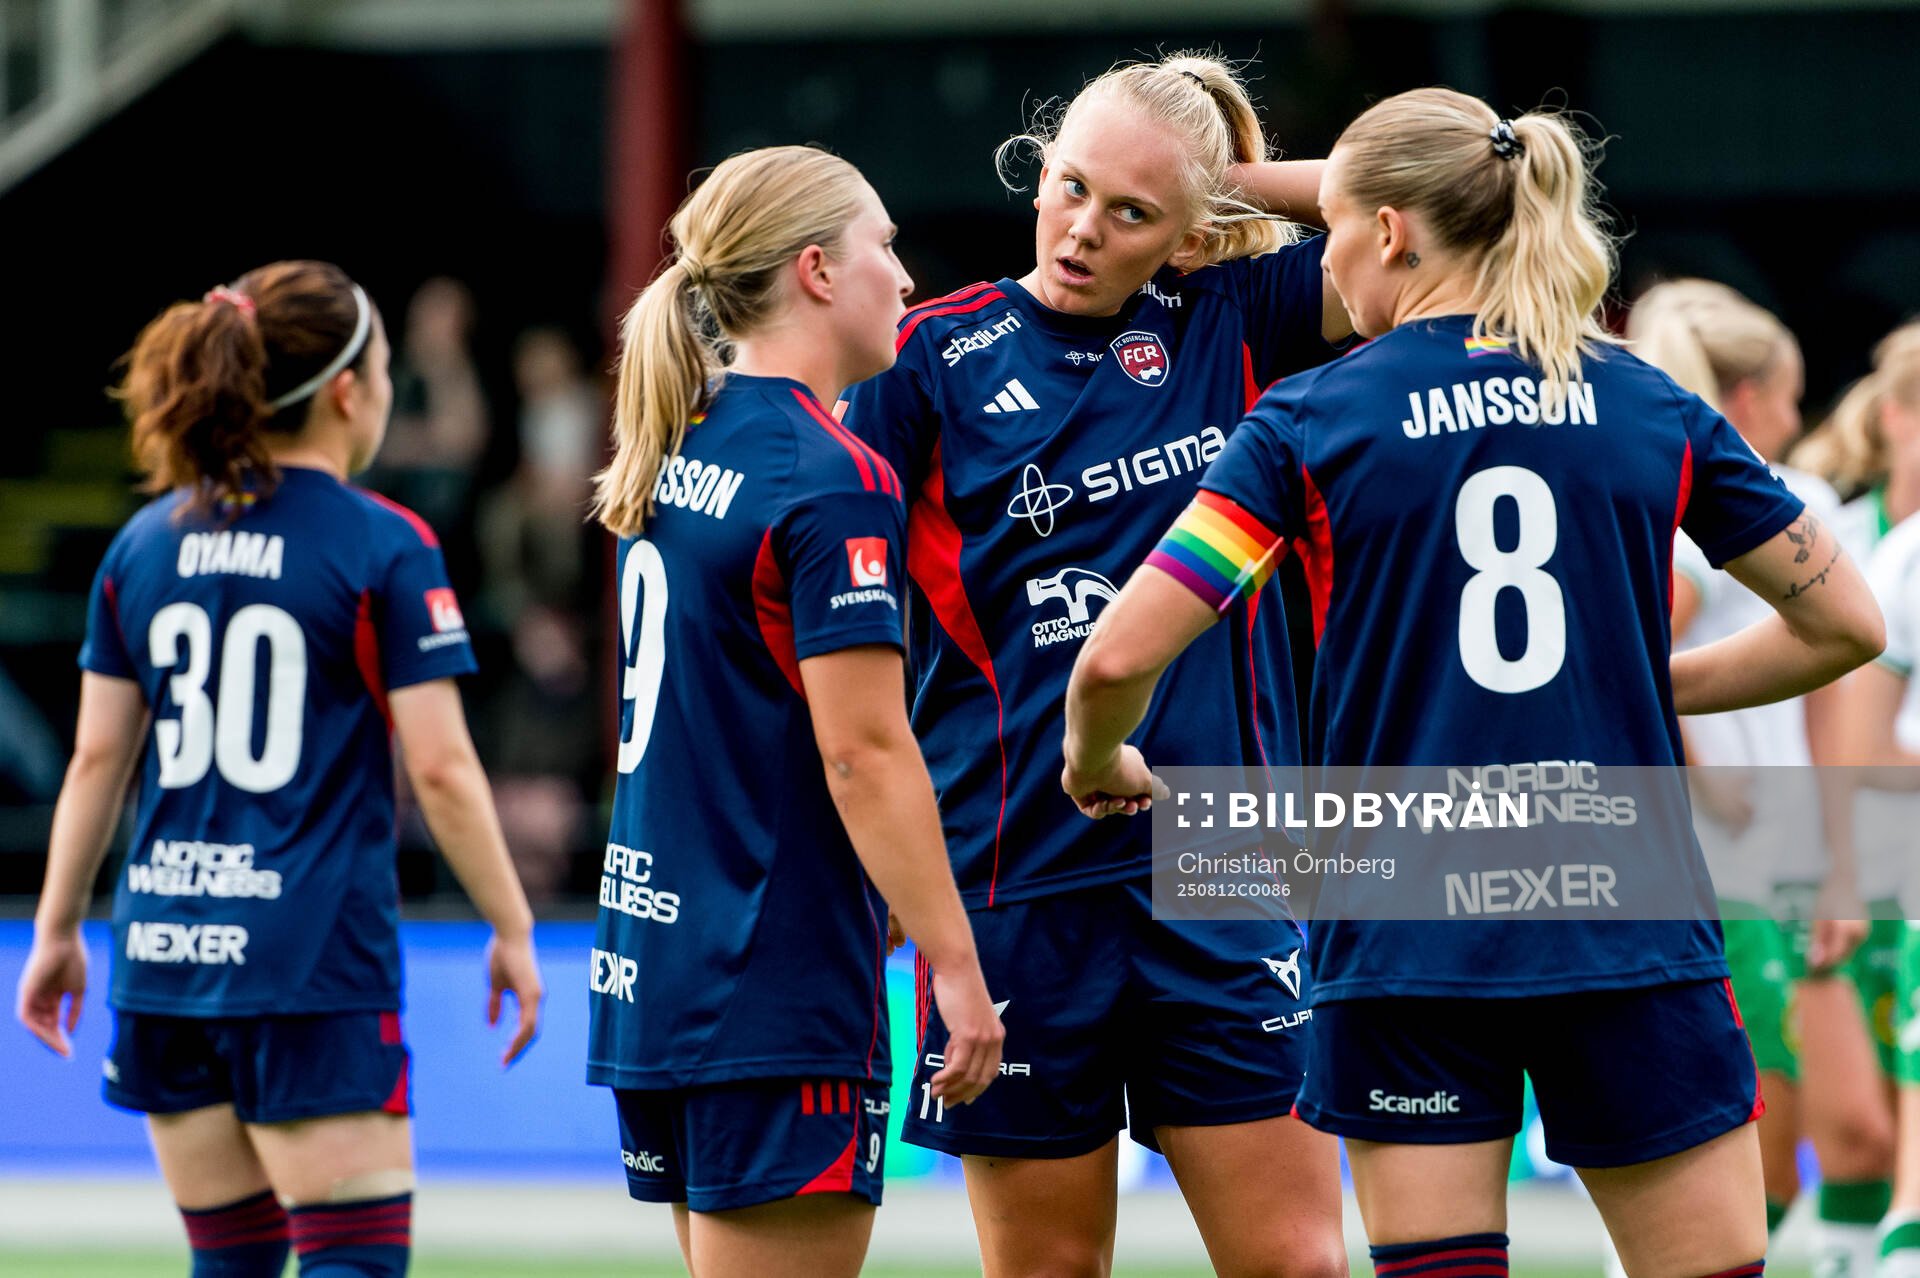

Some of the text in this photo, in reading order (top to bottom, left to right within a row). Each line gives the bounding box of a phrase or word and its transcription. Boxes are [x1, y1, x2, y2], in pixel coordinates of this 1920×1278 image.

[942, 312, 1021, 367] stadium
[1123, 345, 1159, 366] FCR
[1402, 377, 1598, 439] JANSSON
[178, 531, 284, 580] OYAMA
[1455, 465, 1567, 694] 8
[1032, 617, 1070, 636] OTTO
[617, 539, 669, 774] 9
[148, 602, 307, 793] 30
[1446, 760, 1599, 798] NORDIC
[150, 838, 255, 870] NORDIC
[129, 864, 283, 899] WELLNESS
[919, 1082, 945, 1123] 11
[1369, 1088, 1460, 1114] Scandic
[866, 1132, 880, 1174] 9
